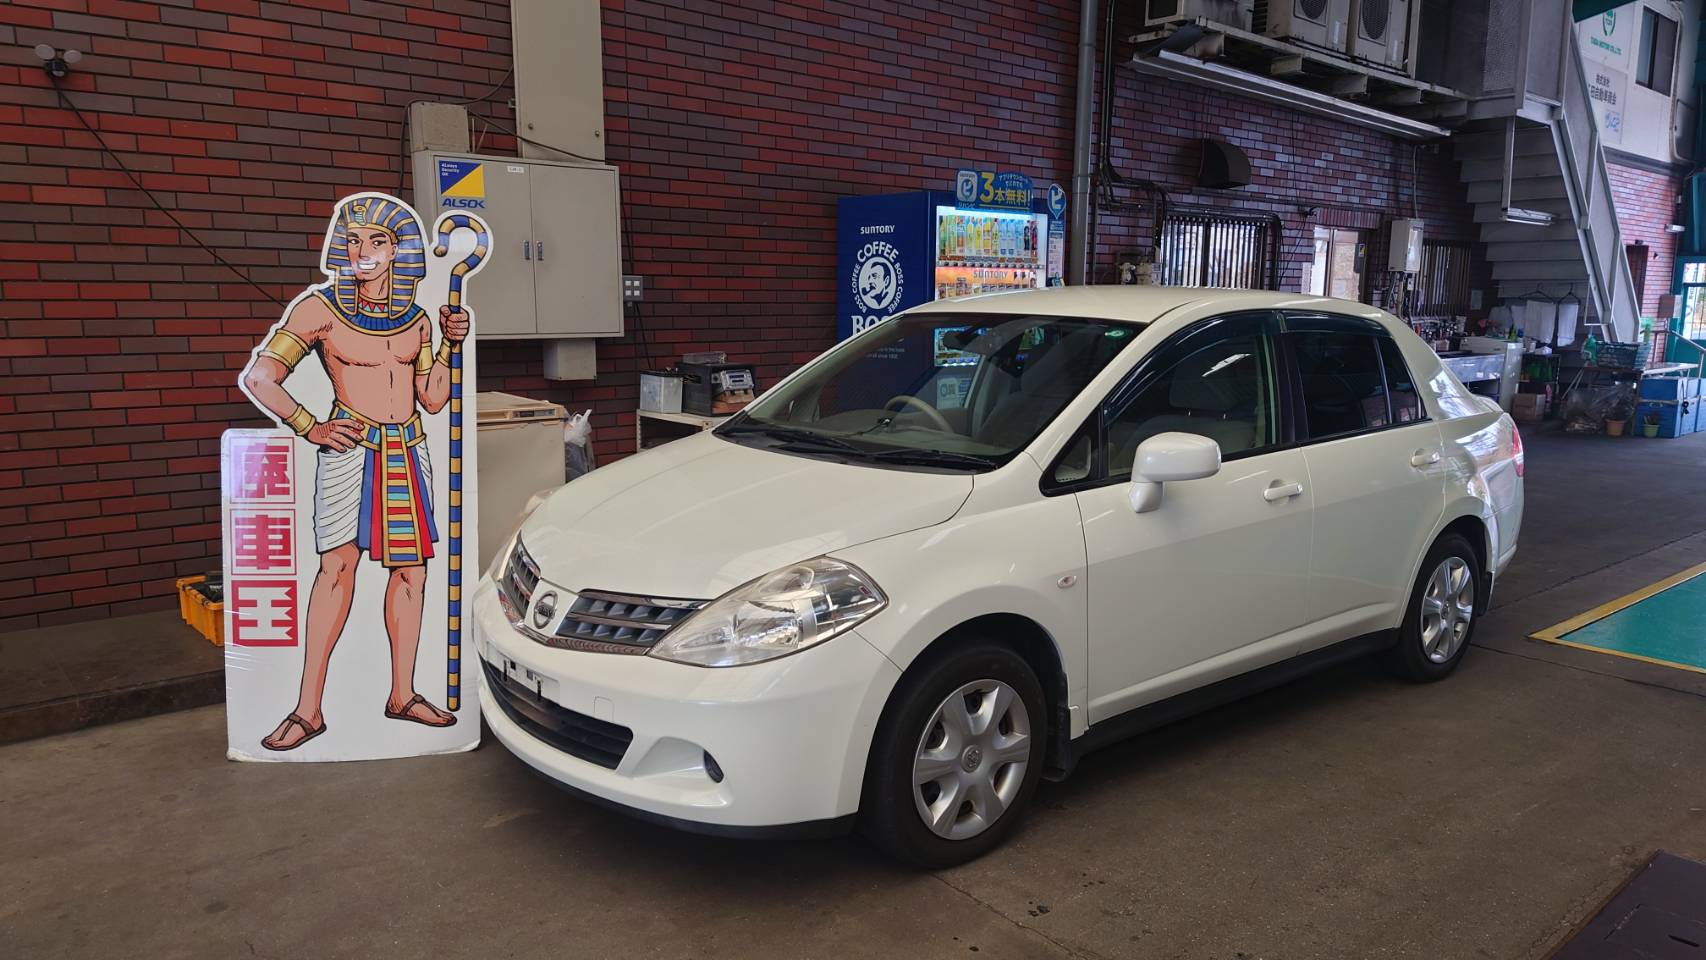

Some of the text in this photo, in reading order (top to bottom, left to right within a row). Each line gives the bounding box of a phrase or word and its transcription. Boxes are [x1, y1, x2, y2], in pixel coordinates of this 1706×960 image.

[442, 198, 486, 208] ALSOK
[860, 225, 895, 235] SUNTORY
[857, 241, 899, 263] COFFEE
[974, 270, 1008, 279] SUNTORY
[851, 263, 868, 314] BOSS COFFEE
[888, 262, 904, 313] BOSS COFFEE
[851, 315, 892, 337] BO
[233, 442, 293, 640] 廃車王
